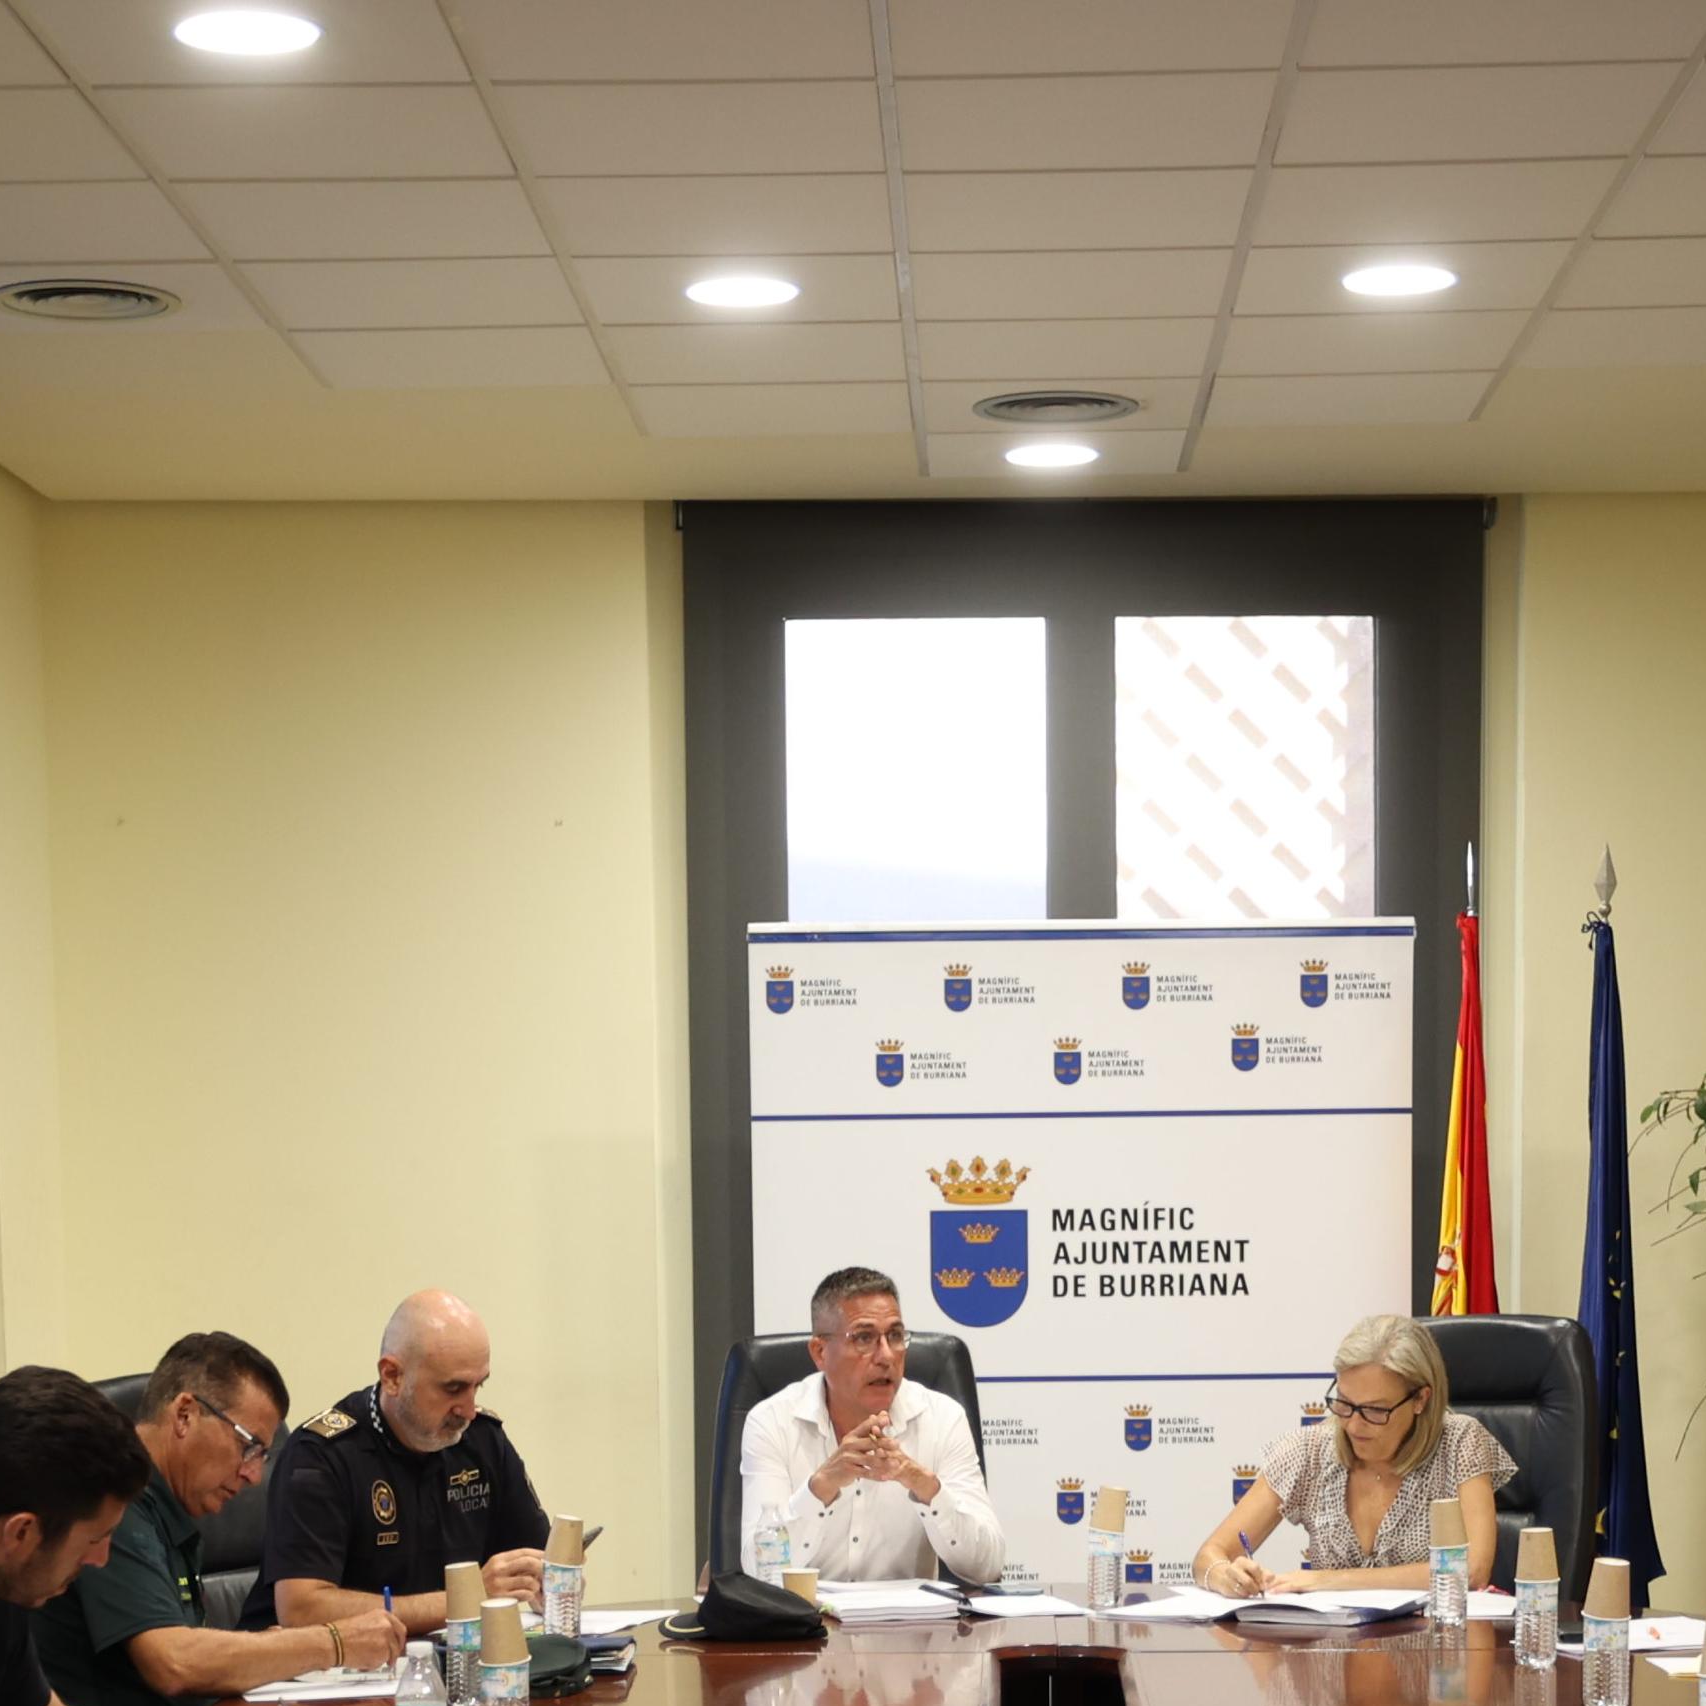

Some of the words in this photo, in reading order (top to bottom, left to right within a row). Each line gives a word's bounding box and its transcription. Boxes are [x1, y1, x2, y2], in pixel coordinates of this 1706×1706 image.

[978, 986, 1035, 994] AJUNTAMENT
[1156, 984, 1213, 992] AJUNTAMENT
[1335, 982, 1392, 990] AJUNTAMENT
[800, 988, 857, 997] AJUNTAMENT
[1335, 991, 1344, 1000] DE
[1348, 991, 1392, 1000] BURRIANA
[800, 998, 810, 1006] DE
[814, 998, 857, 1006] BURRIANA
[978, 996, 988, 1004] DE
[992, 996, 1035, 1004] BURRIANA
[1156, 994, 1166, 1002] DE
[1170, 994, 1213, 1002] BURRIANA
[1266, 1046, 1322, 1054] AJUNTAMENT
[1088, 1059, 1145, 1067] AJUNTAMENT
[1266, 1055, 1275, 1063] DE
[1279, 1055, 1322, 1063] BURRIANA
[910, 1061, 967, 1070] AJUNTAMENT
[910, 1071, 919, 1079] DE
[924, 1071, 967, 1079] BURRIANA
[1088, 1069, 1098, 1077] DE
[1102, 1069, 1145, 1077] BURRIANA
[1052, 1201, 1194, 1232] MAGNÍFIC
[1053, 1239, 1250, 1265] AJUNTAMENT
[1052, 1274, 1086, 1298] DE
[1099, 1272, 1249, 1298] BURRIANA
[1159, 1426, 1215, 1434] AJUNTAMENT
[1159, 1435, 1168, 1444] DE
[1172, 1435, 1215, 1444] BURRIANA
[447, 1482, 490, 1502] POLICIA
[1159, 1562, 1191, 1570] MAGNÍF
